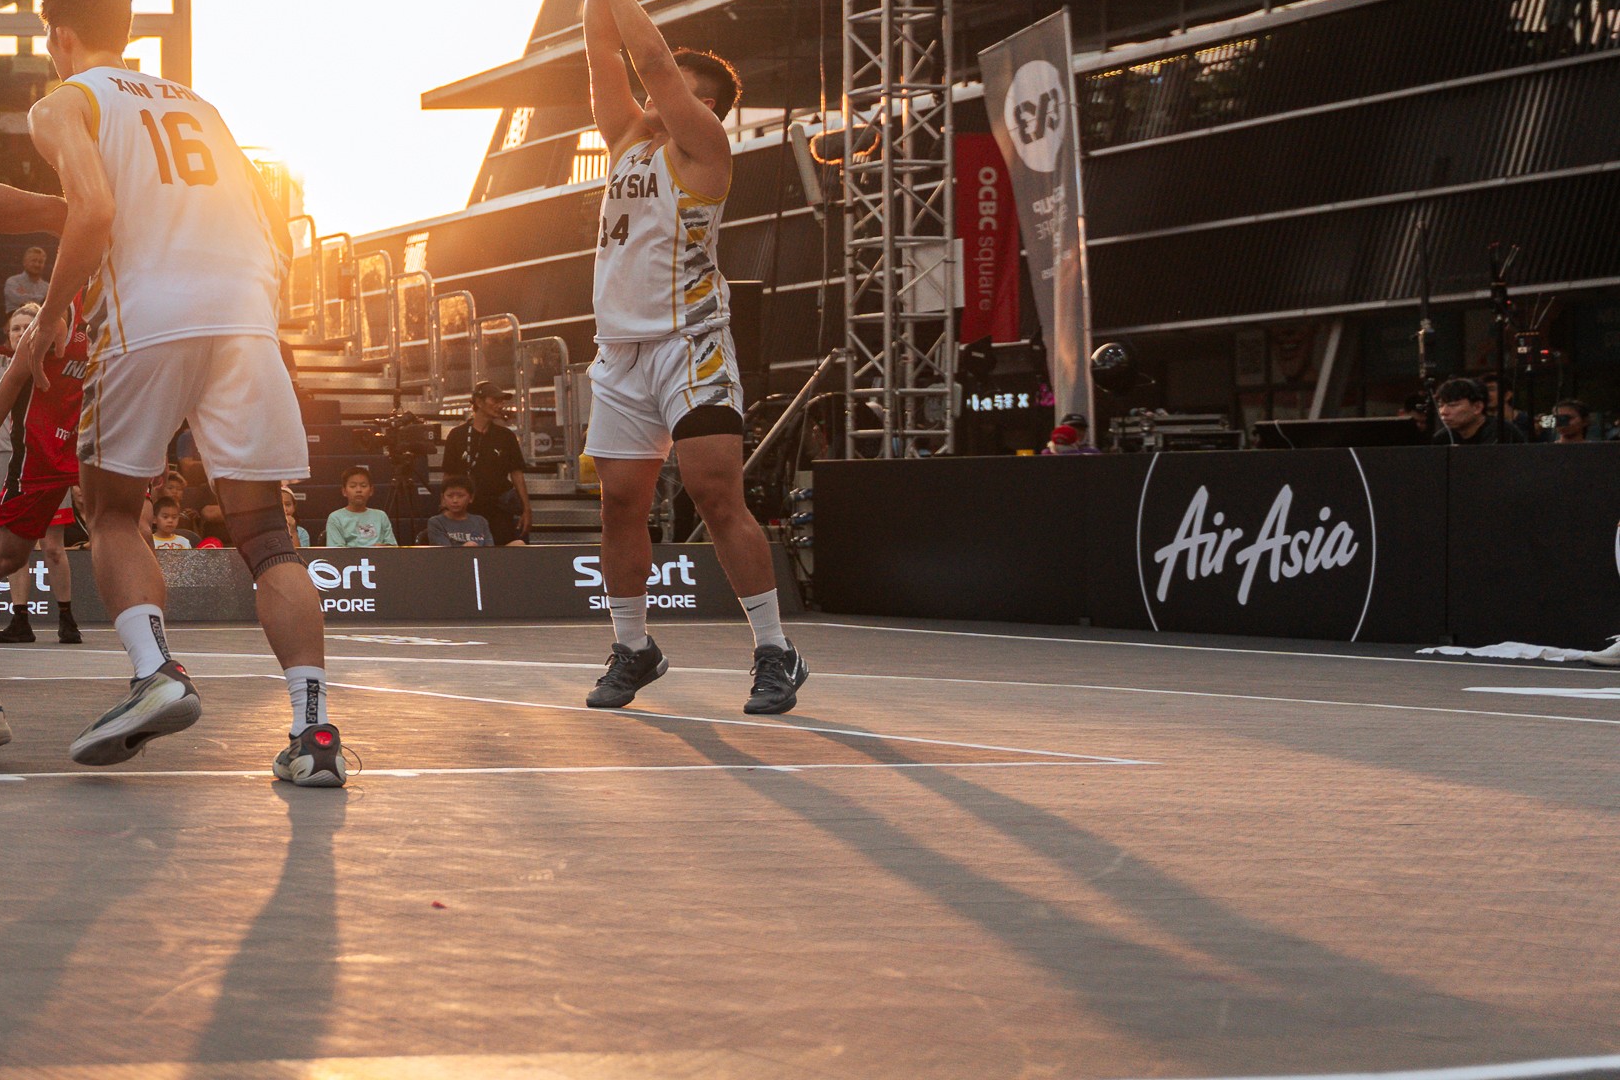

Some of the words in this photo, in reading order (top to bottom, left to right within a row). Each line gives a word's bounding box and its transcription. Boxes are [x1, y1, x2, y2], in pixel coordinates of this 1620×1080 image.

[108, 77, 154, 99] XIN
[140, 109, 219, 187] 16
[978, 166, 997, 231] OCBC
[974, 236, 996, 311] square
